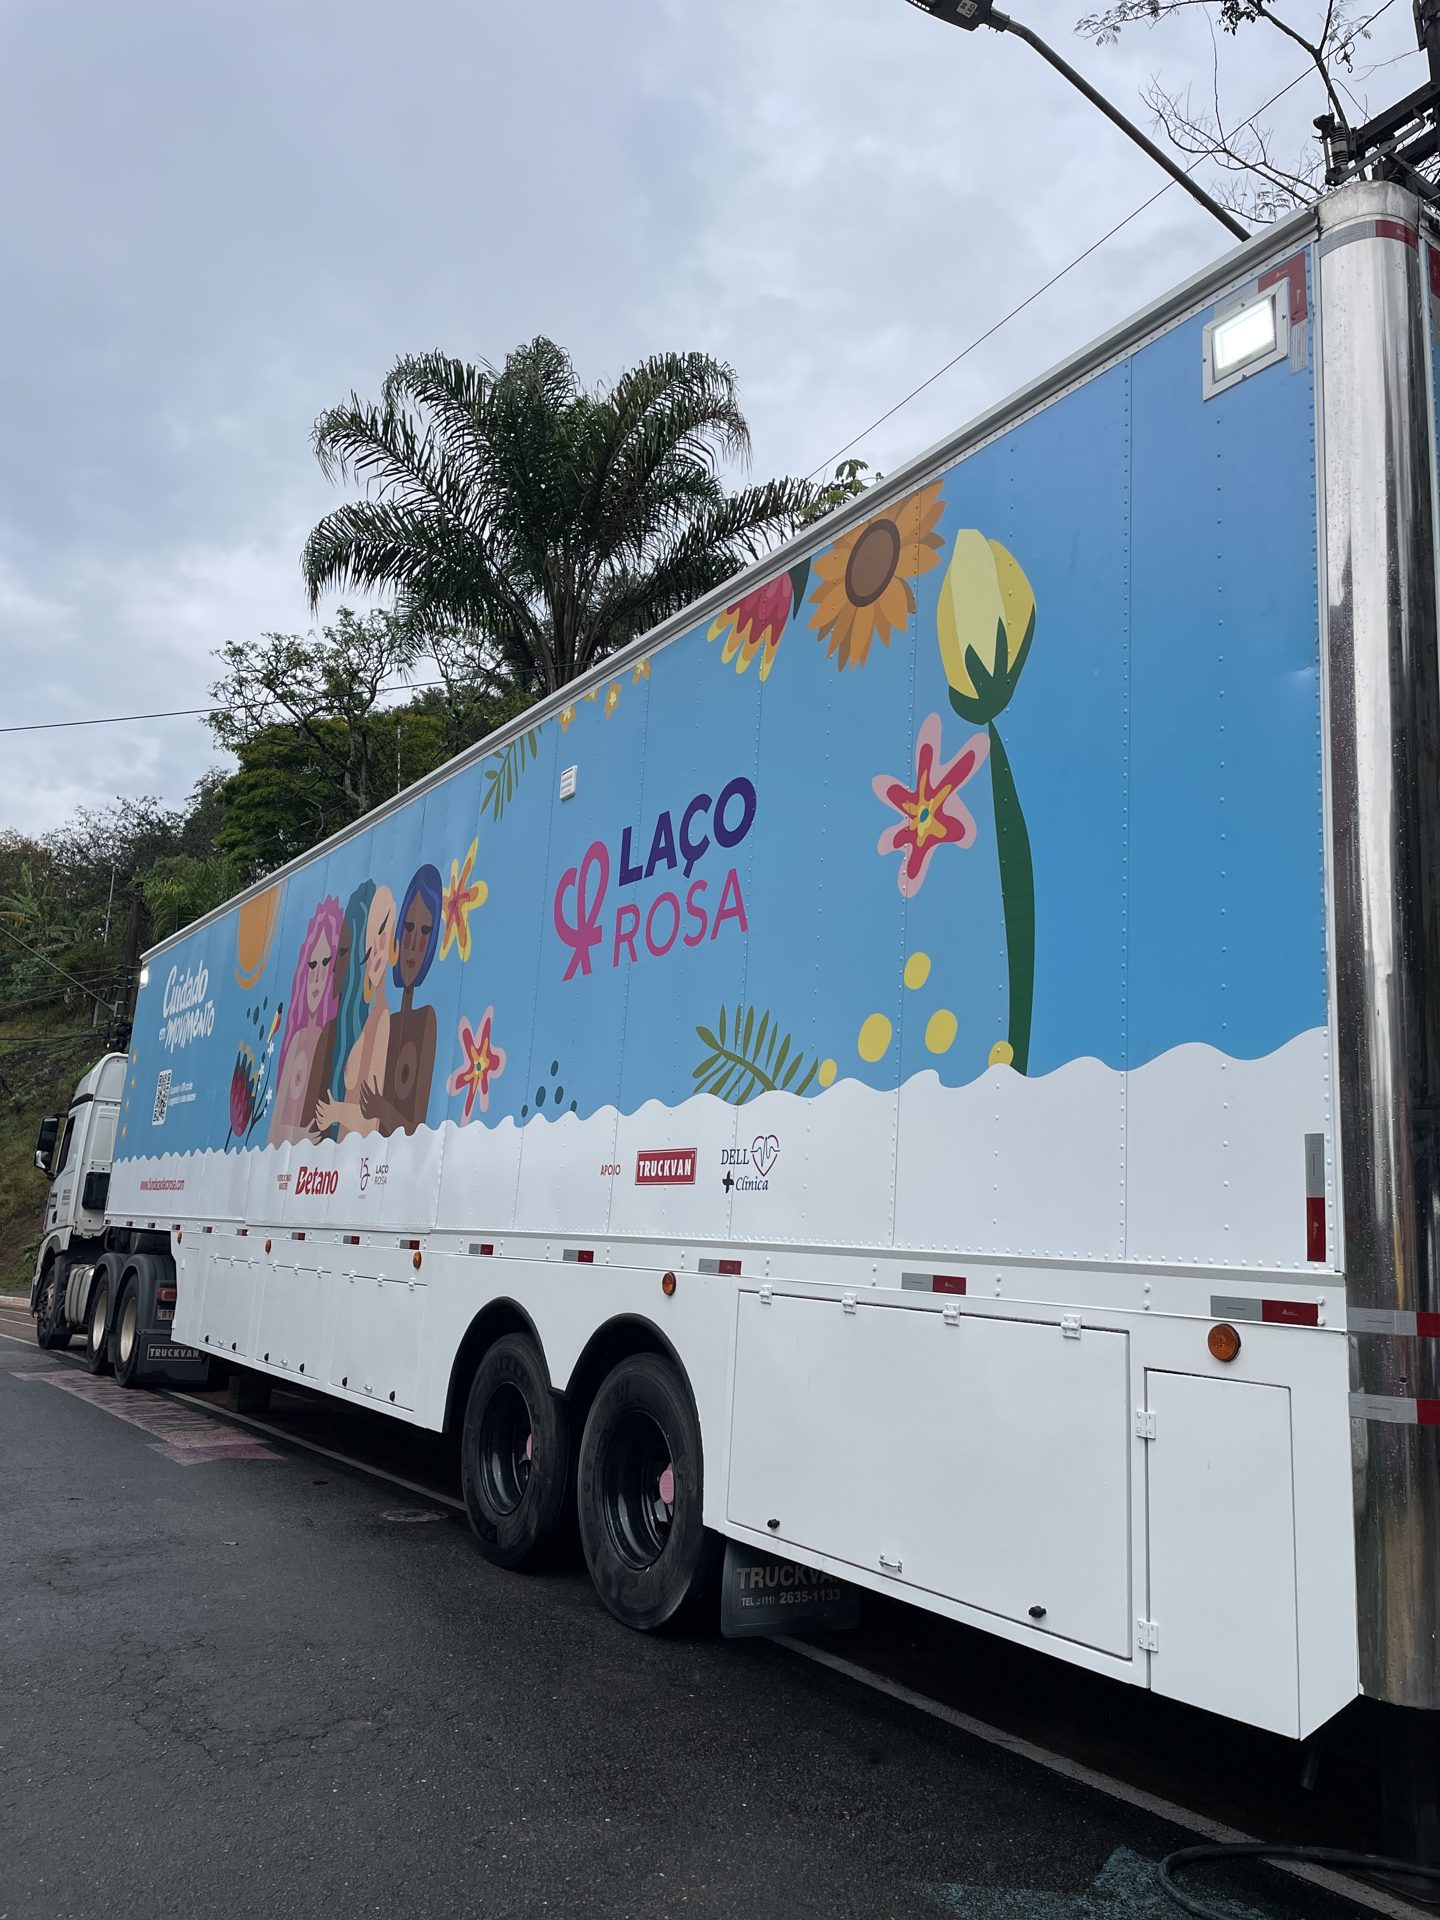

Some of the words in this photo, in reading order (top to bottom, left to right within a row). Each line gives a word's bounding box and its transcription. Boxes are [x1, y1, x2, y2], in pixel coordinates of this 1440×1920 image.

[618, 776, 757, 887] LAÇO
[612, 868, 749, 968] ROSA
[163, 959, 209, 1018] Cuidado
[721, 1149, 749, 1165] DELL
[638, 1158, 692, 1177] TRUCKVAN
[295, 1166, 339, 1195] Betano
[374, 1175, 388, 1186] ROSA
[150, 1348, 200, 1358] TRUCKVAN
[779, 1589, 841, 1604] 2635-1133
